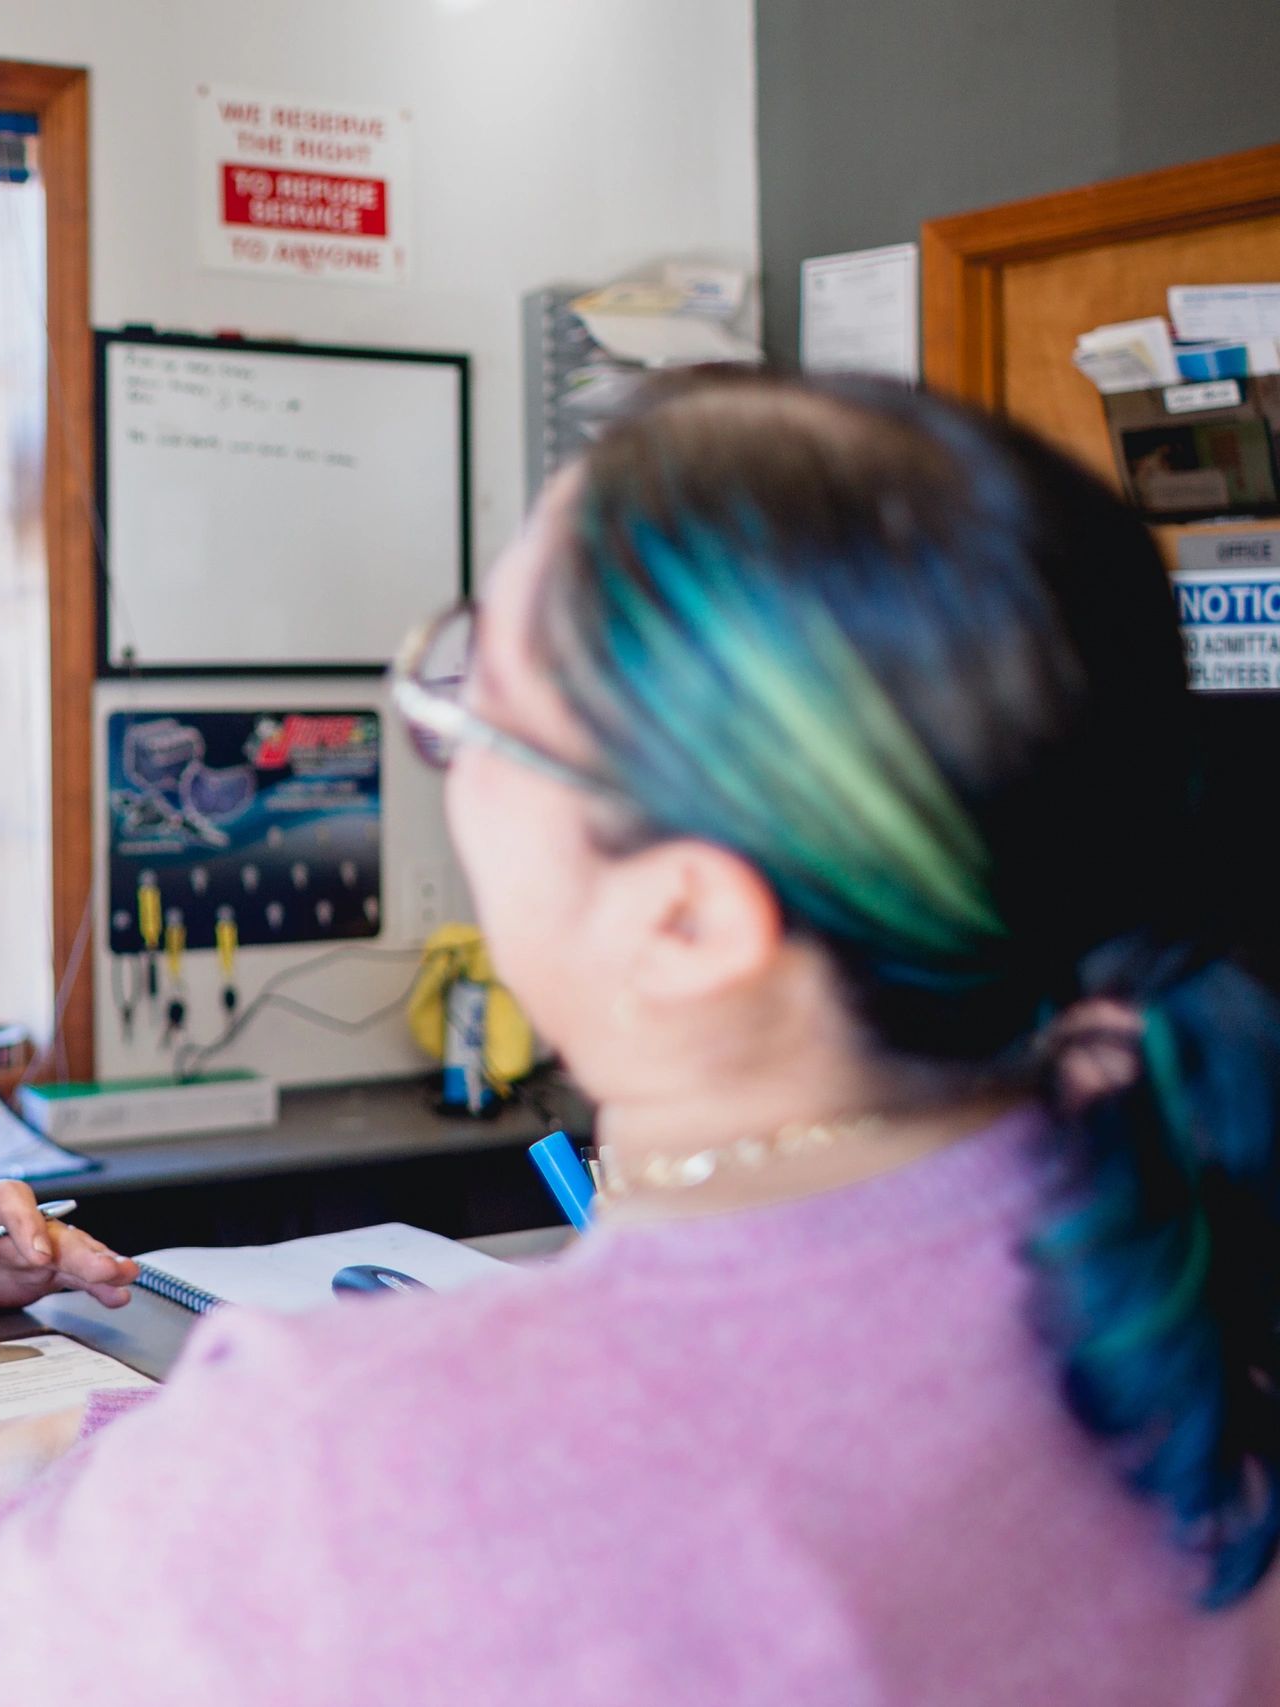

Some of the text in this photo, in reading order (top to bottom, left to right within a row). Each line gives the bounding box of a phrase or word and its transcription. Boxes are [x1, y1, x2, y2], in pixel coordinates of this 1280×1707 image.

[218, 102, 384, 139] WE RESERVE
[237, 129, 372, 163] THE RIGHT
[233, 170, 378, 210] TO REFUSE
[248, 198, 362, 232] SERVICE
[231, 236, 266, 261] TO
[272, 241, 382, 269] ANYONE
[1217, 540, 1272, 562] OFFICE
[1179, 585, 1280, 622] NOTIC
[1204, 632, 1280, 657] ADMITTA
